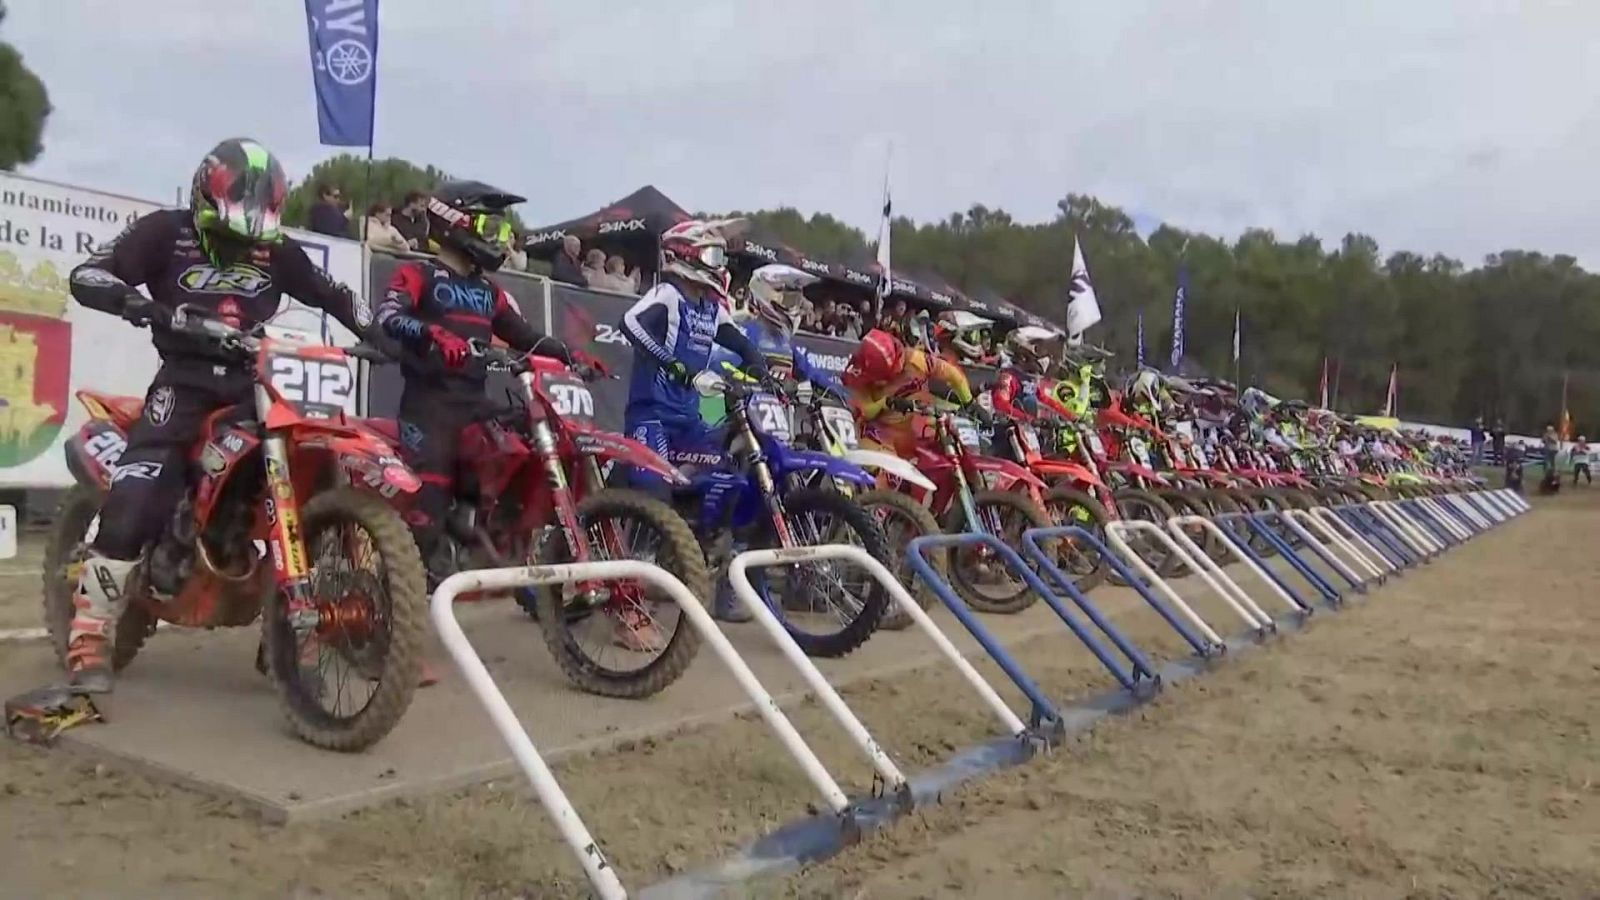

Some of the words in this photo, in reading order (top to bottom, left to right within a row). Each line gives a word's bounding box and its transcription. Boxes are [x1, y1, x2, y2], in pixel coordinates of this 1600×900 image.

[598, 218, 646, 234] 24MX
[40, 226, 64, 252] la
[745, 240, 778, 262] 24MX
[1172, 286, 1185, 349] YAMAHA
[594, 323, 633, 348] 24
[270, 356, 351, 408] 212
[676, 451, 721, 465] CASTRO
